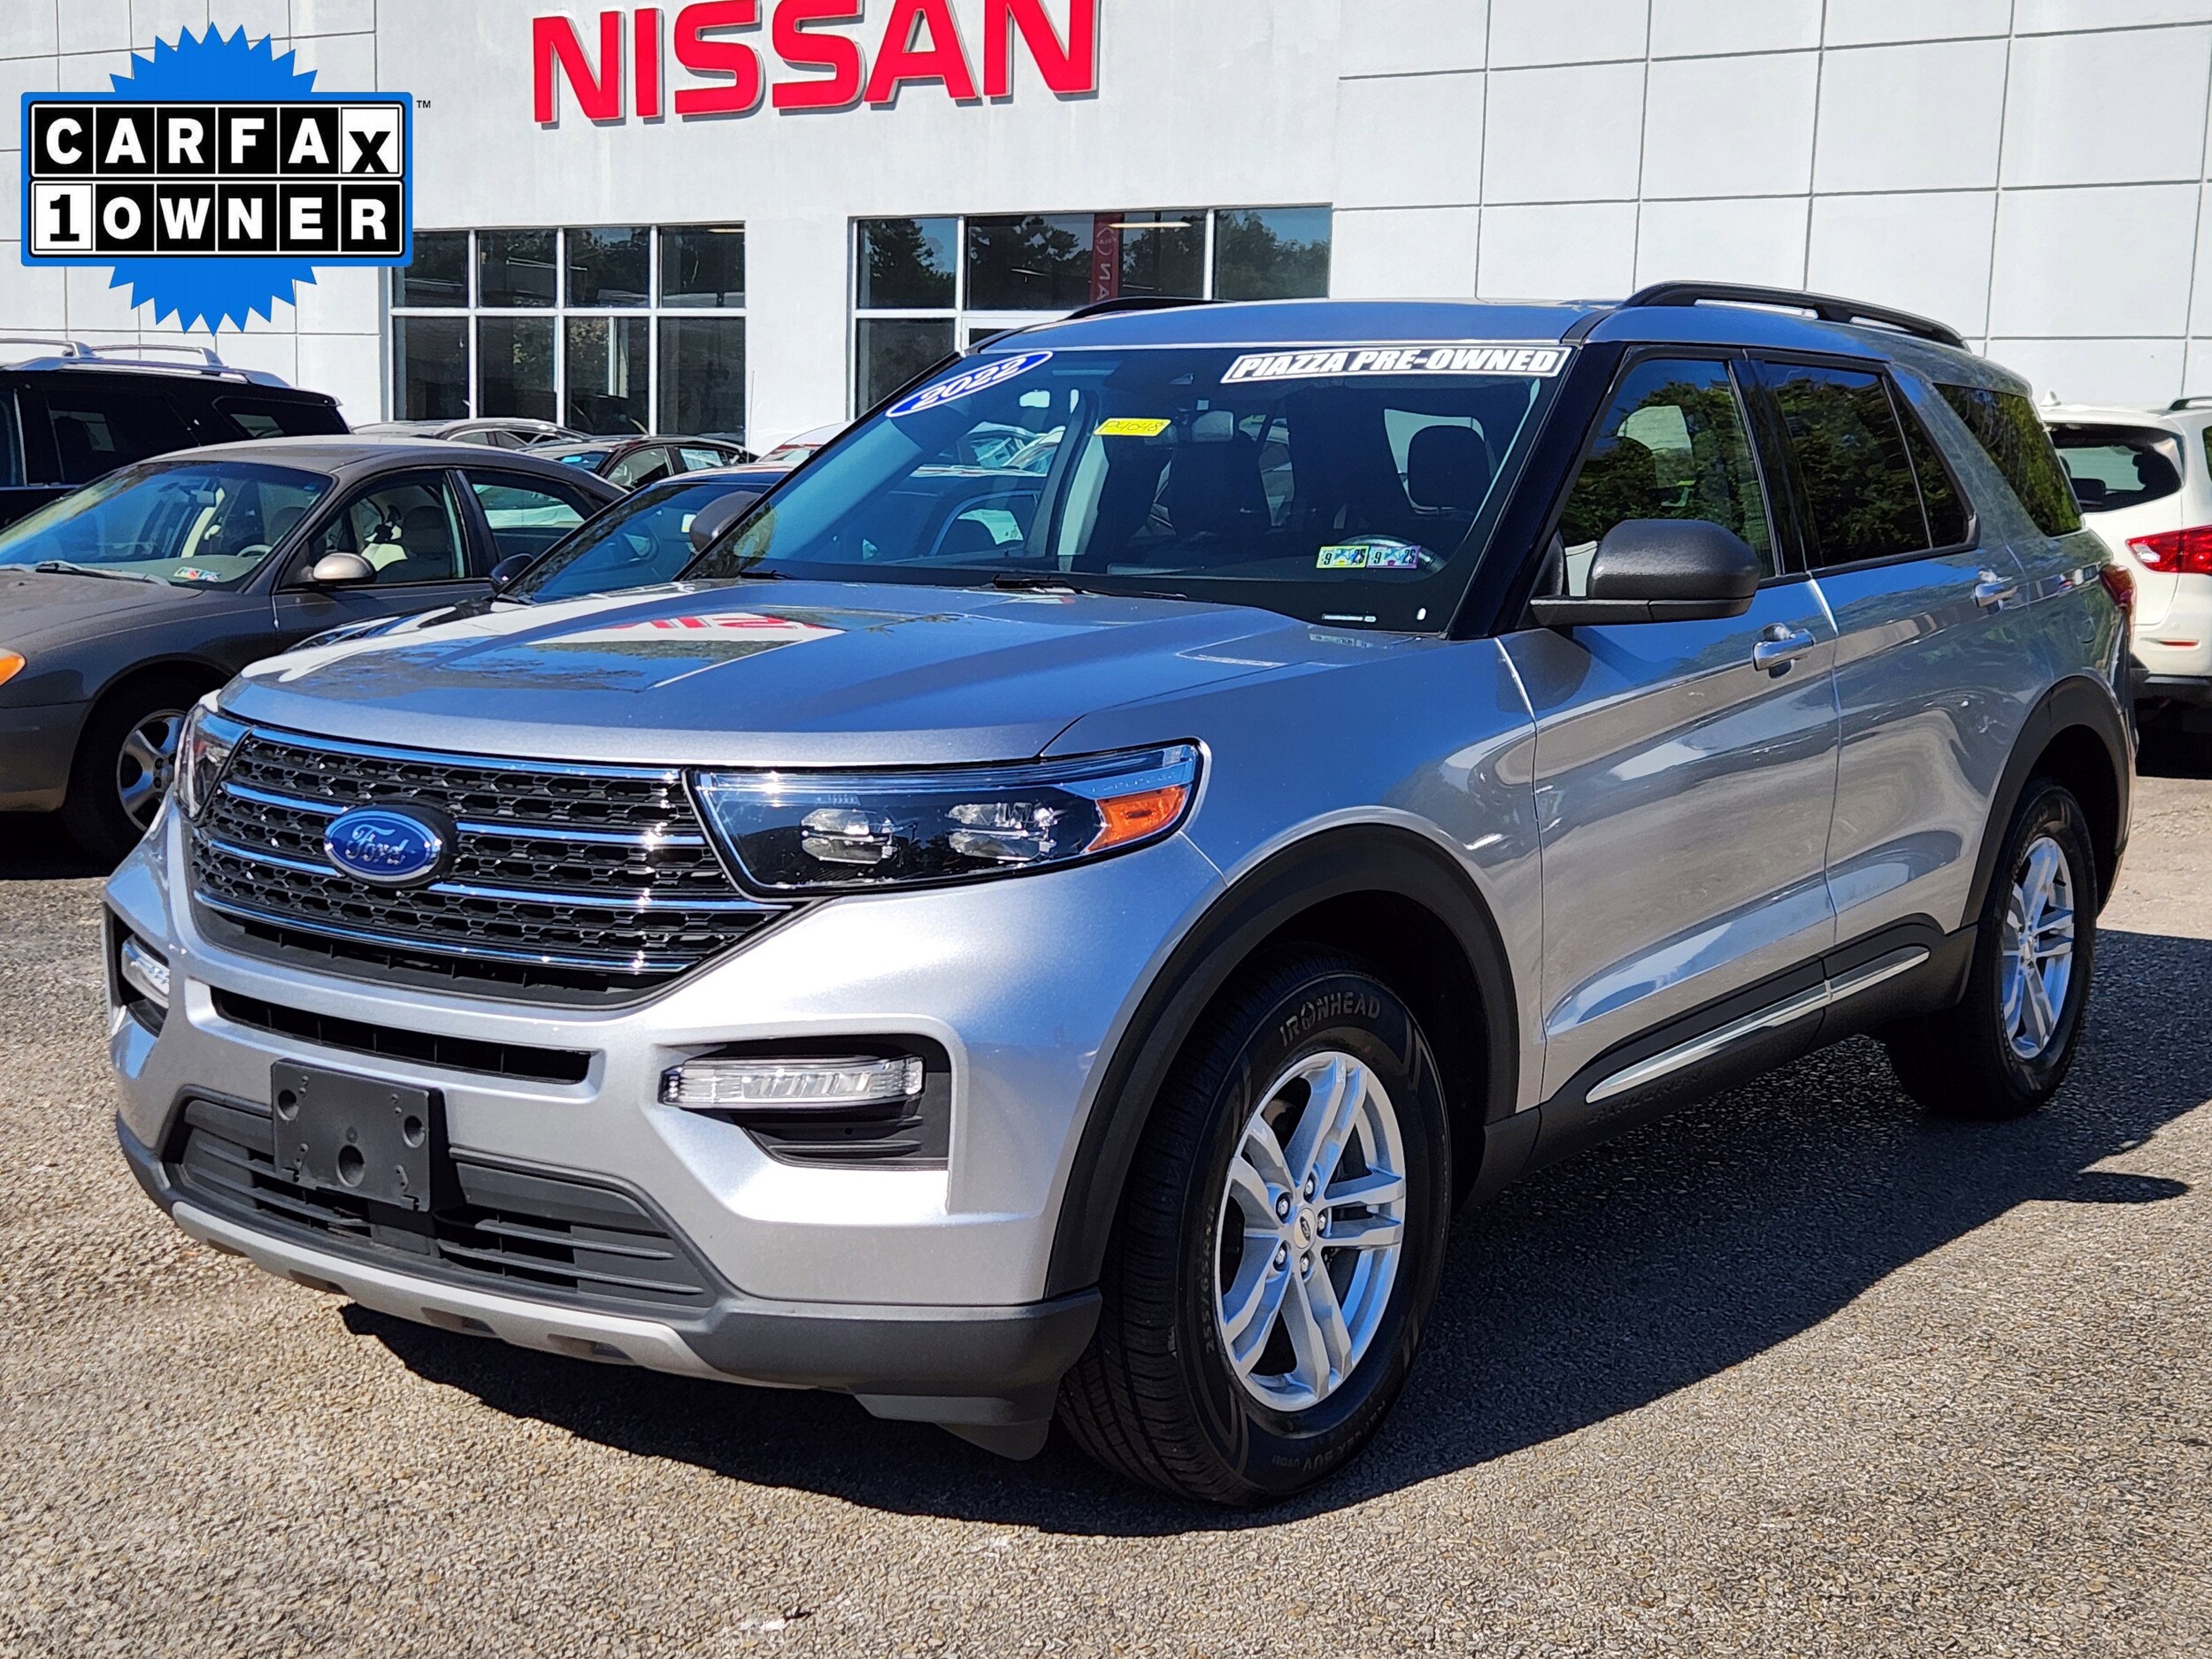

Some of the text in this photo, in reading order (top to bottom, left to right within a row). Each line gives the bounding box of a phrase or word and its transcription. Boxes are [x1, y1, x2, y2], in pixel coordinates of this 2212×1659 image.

[533, 0, 1100, 124] NISSAN
[910, 357, 1027, 411] 2022
[1233, 349, 1560, 379] PIAZZA PRE-OWNED
[1324, 552, 1333, 565] 9
[1373, 551, 1382, 564] 9
[345, 824, 410, 865] Ford
[1279, 991, 1381, 1047] IRONHEAD
